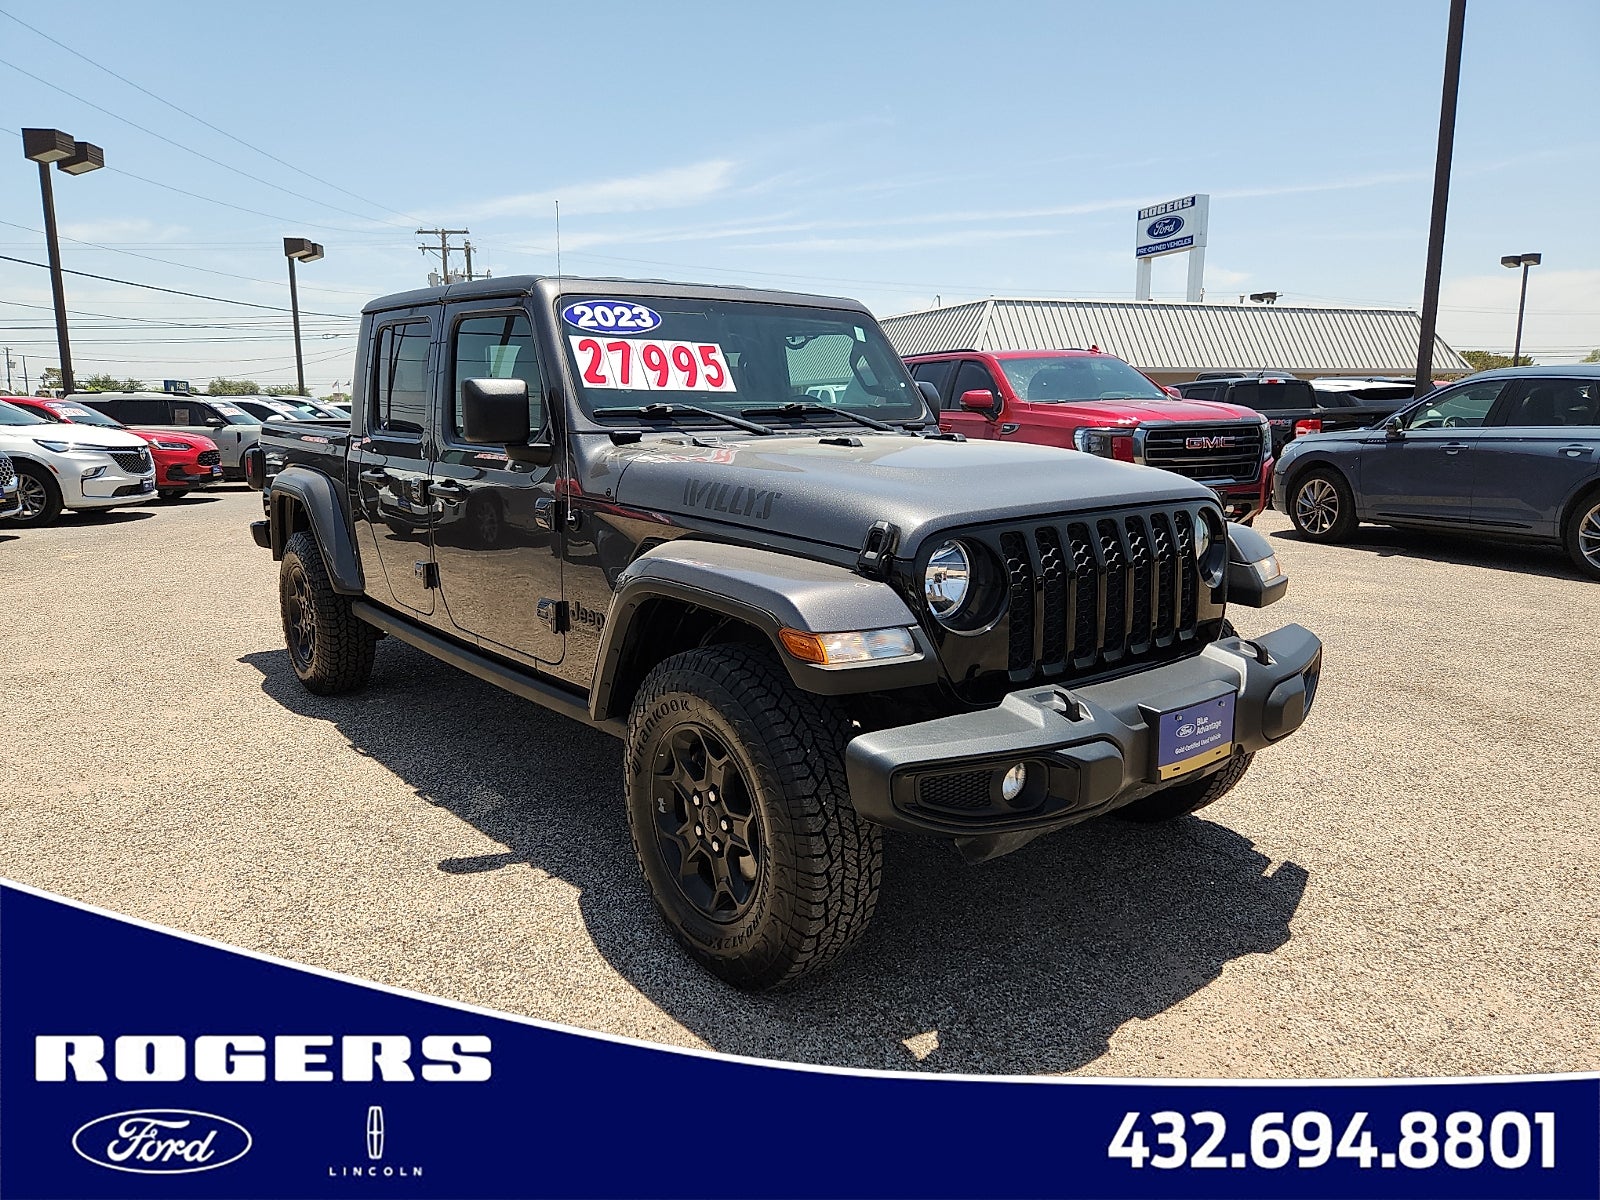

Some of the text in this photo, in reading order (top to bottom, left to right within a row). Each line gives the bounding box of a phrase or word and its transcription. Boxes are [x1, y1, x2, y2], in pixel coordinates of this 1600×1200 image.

[1140, 197, 1193, 219] ROGERS
[1153, 219, 1176, 236] Ford
[573, 304, 654, 328] 2023
[578, 339, 726, 389] 27995
[1185, 436, 1236, 449] GMC
[683, 478, 783, 519] WILLYS
[570, 600, 606, 632] Jeep
[1196, 716, 1209, 726] Blue
[1196, 720, 1222, 736] Advantage
